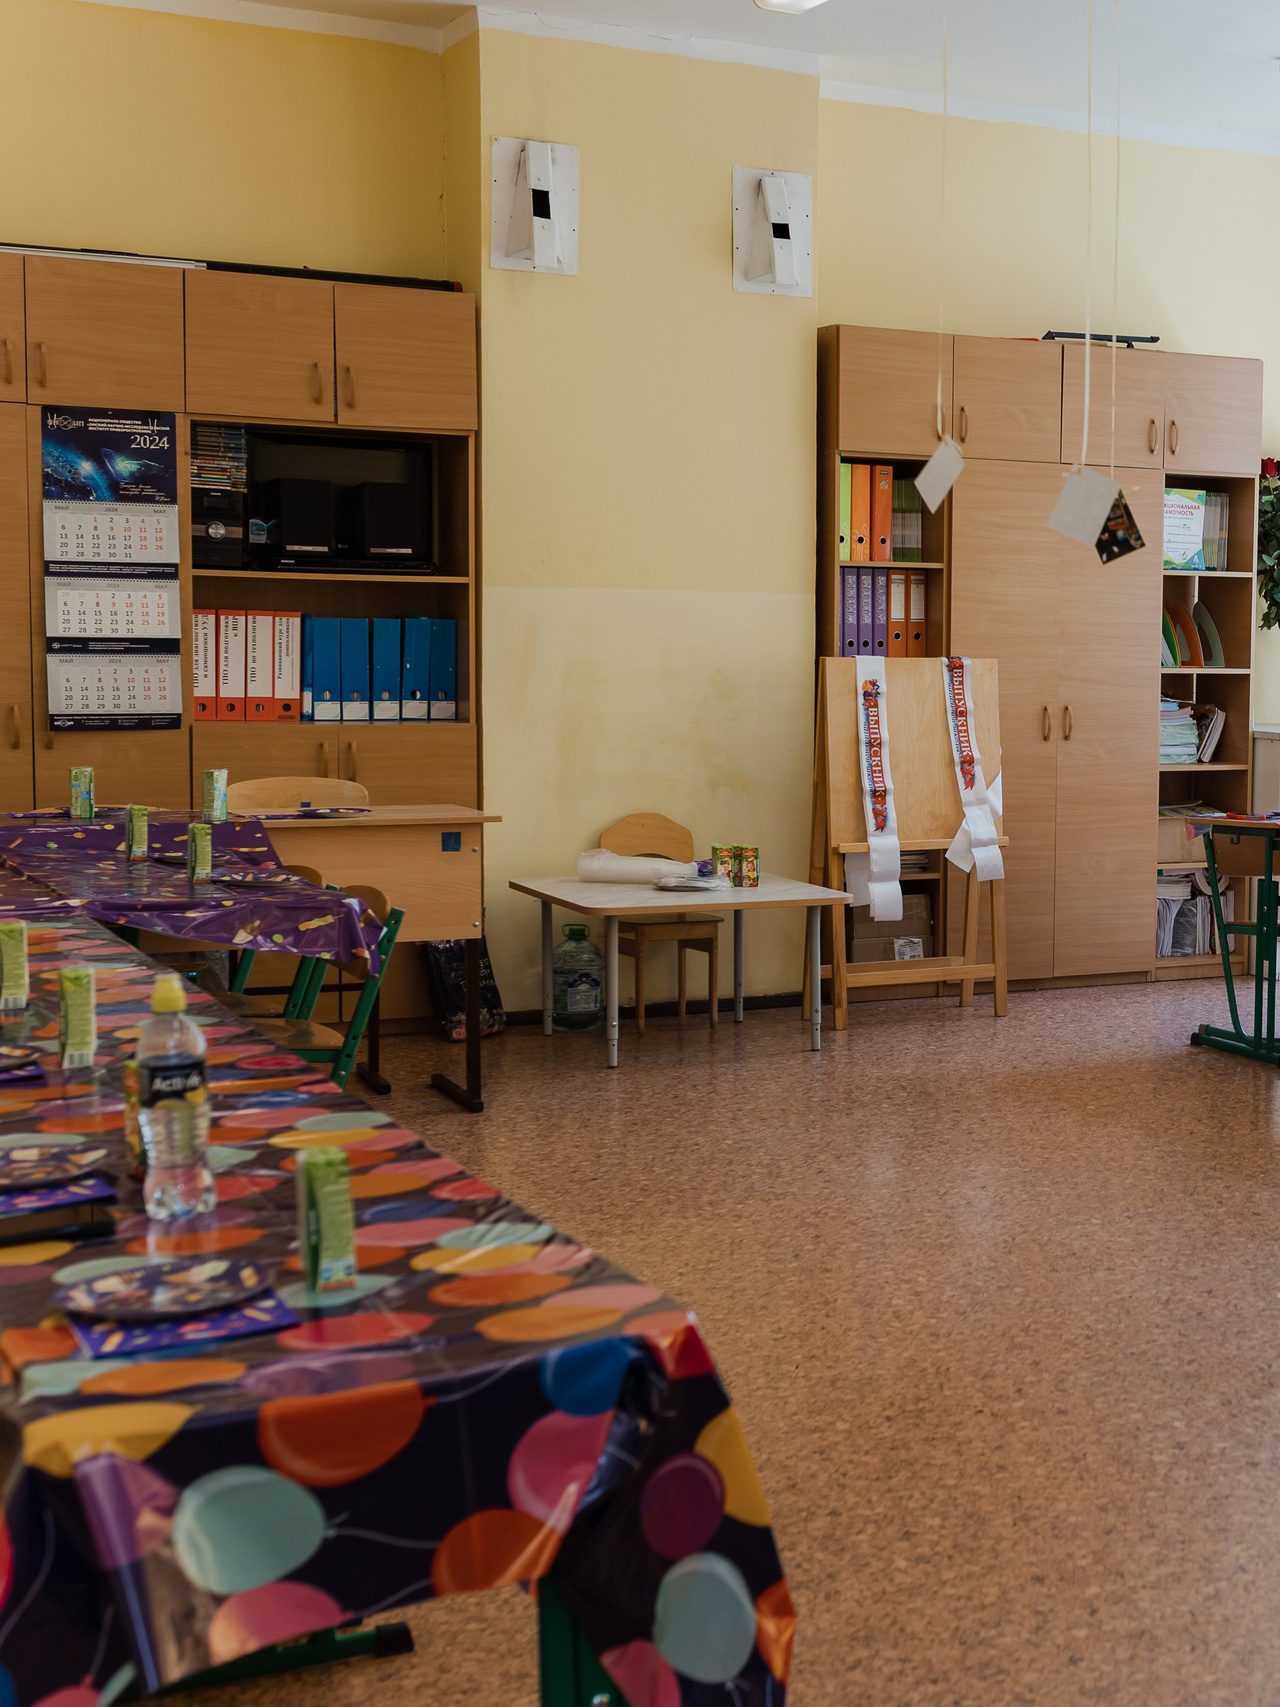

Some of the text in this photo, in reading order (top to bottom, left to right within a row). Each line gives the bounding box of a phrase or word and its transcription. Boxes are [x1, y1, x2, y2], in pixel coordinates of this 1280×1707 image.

[130, 434, 170, 450] 2024
[252, 655, 257, 664] по
[953, 669, 972, 756] ВЫПУСКНИК
[868, 707, 885, 796] ВЫПУСКНИК
